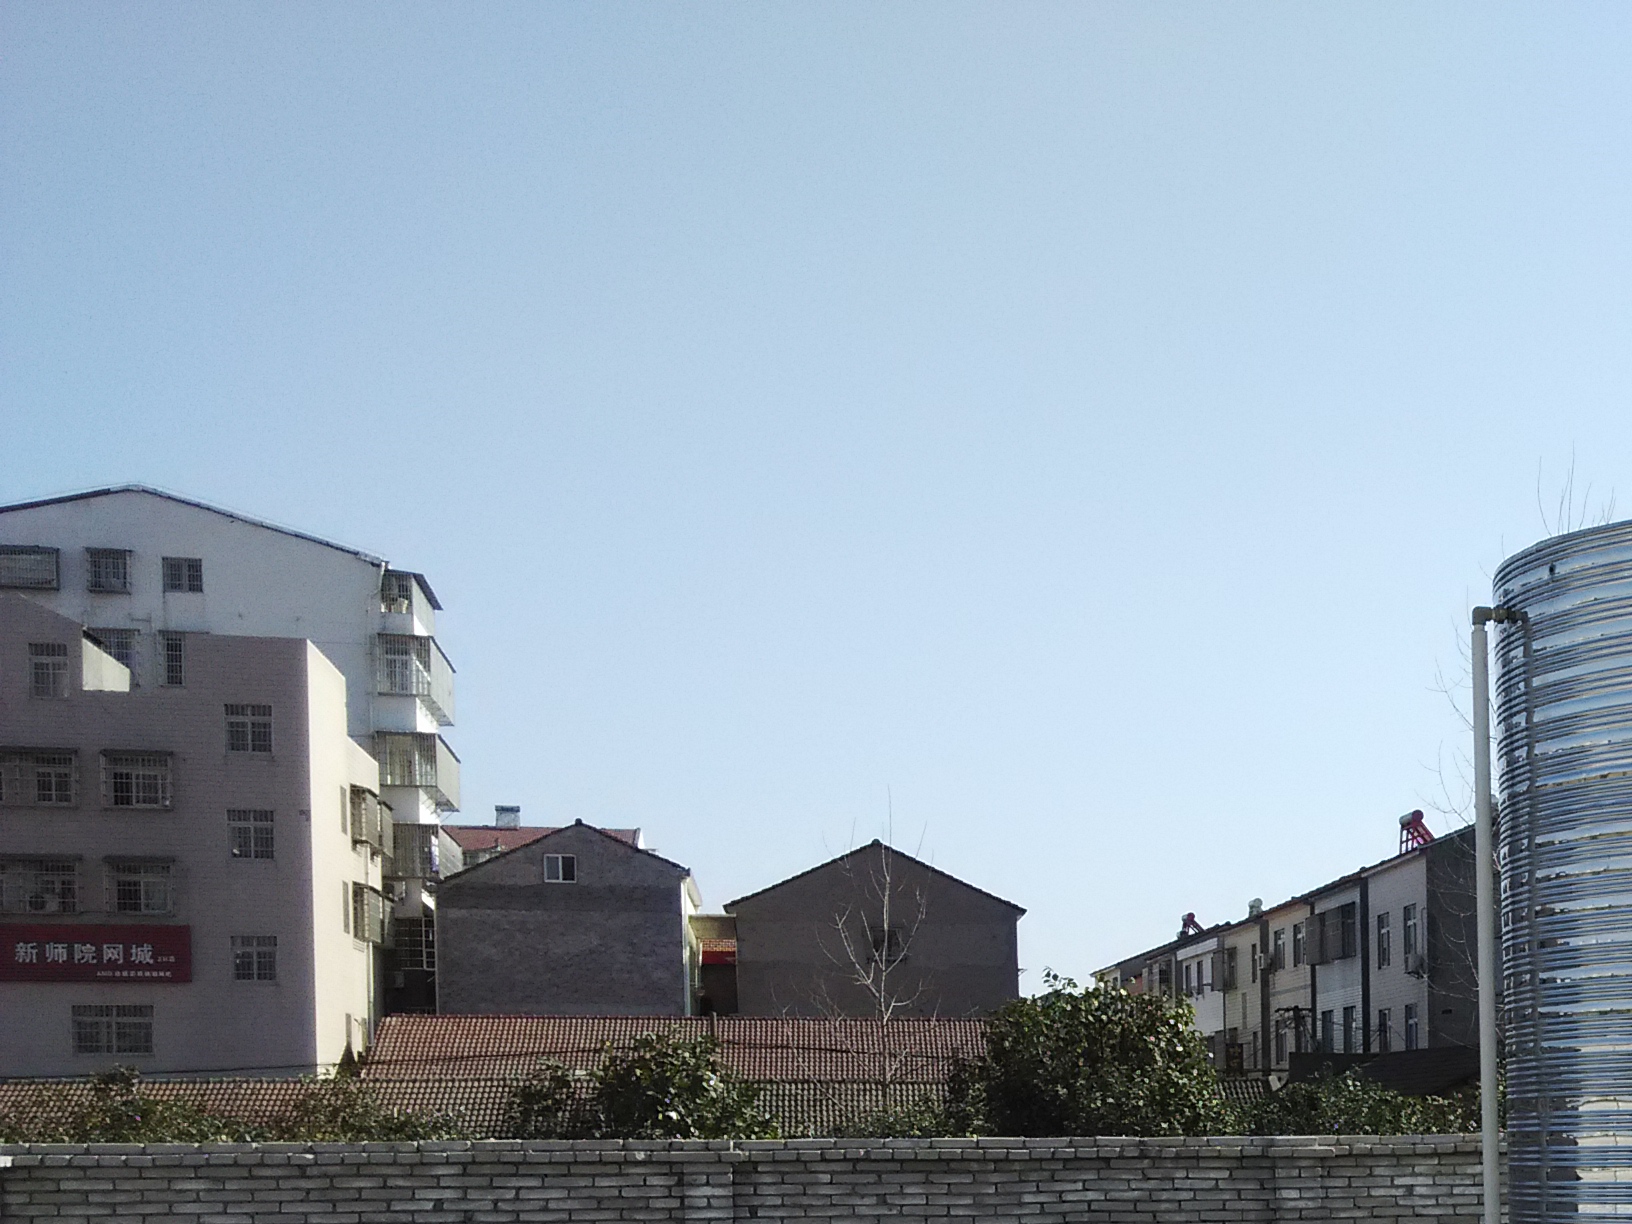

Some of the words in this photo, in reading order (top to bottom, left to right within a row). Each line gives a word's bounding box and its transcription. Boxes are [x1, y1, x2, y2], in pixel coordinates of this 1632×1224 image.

[14, 942, 155, 965] 新师院网城
